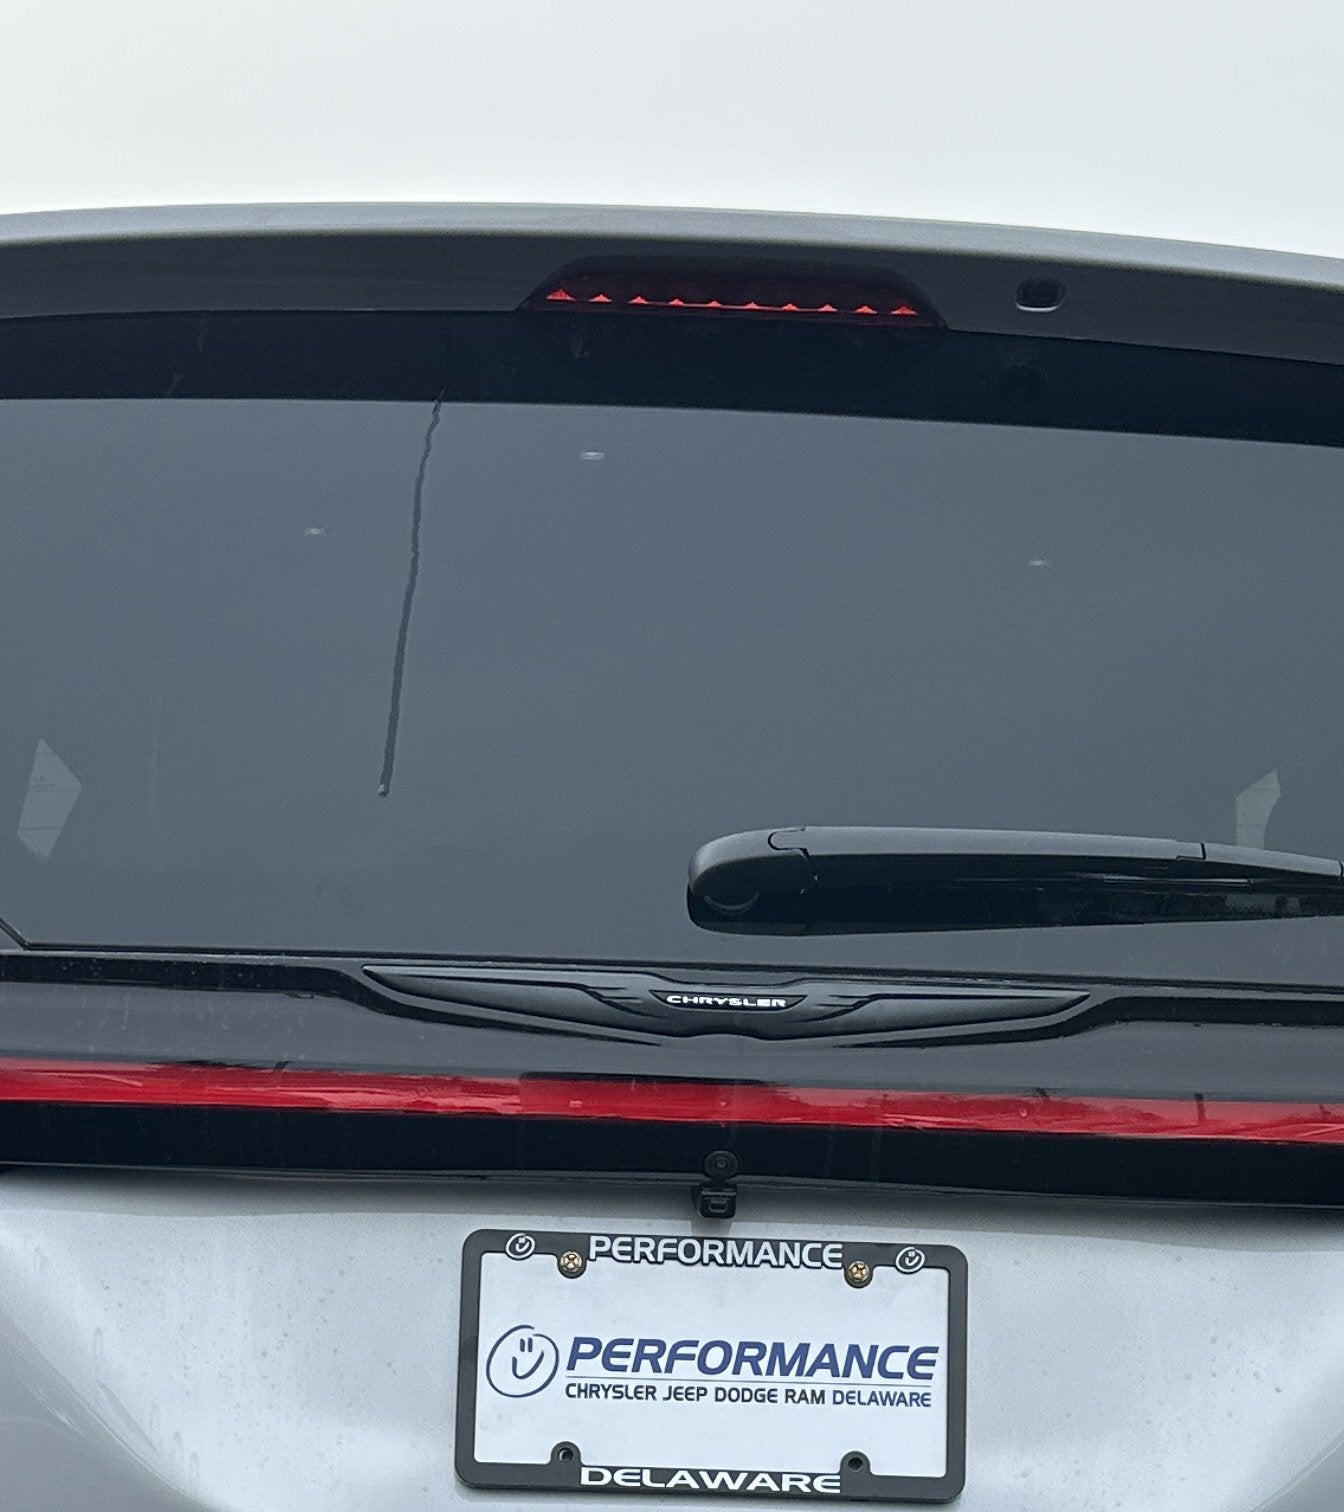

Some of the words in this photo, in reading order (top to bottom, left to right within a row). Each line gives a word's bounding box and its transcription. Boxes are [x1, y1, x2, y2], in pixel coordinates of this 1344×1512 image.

[666, 995, 786, 1007] CHRYSLER
[588, 1235, 844, 1269] PERFORMANCE
[565, 1335, 939, 1380] PERFORMANCE
[565, 1382, 657, 1402] CHRYSLER
[662, 1386, 708, 1402] JEEP
[714, 1386, 778, 1404] DODGE
[784, 1388, 826, 1406] RAM
[832, 1389, 932, 1408] DELAWARE
[580, 1466, 841, 1494] DELAWARE
